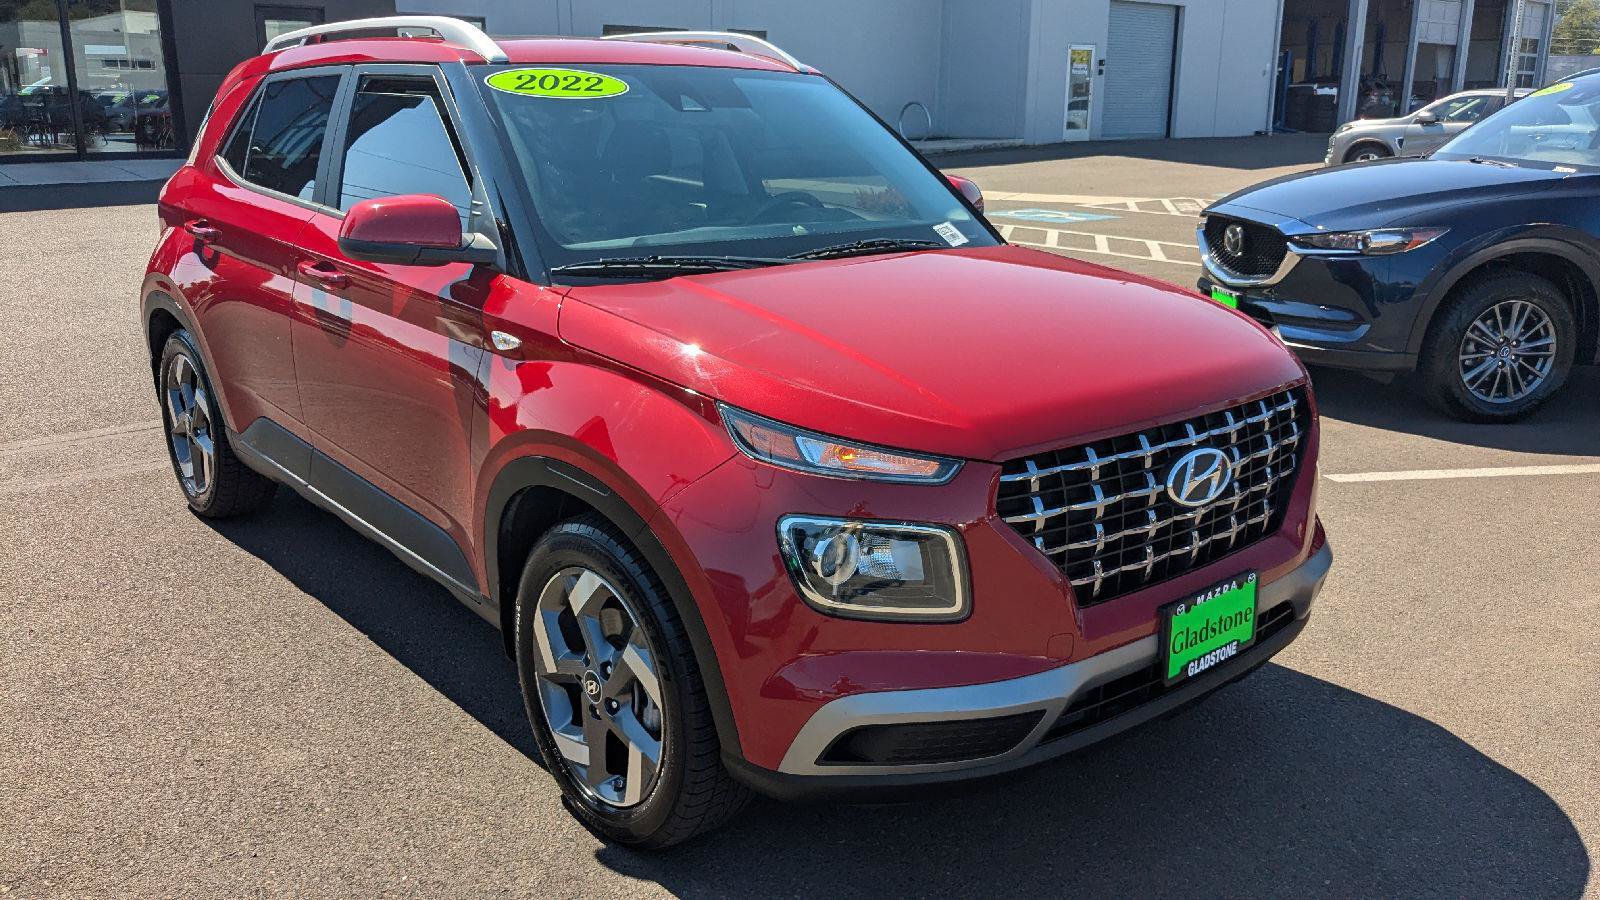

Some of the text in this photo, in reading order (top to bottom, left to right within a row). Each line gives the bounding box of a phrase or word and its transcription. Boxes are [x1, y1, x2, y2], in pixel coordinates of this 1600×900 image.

[514, 74, 604, 92] 2022
[1196, 580, 1238, 606] MAZDA
[1171, 606, 1253, 655] Gladstone
[1187, 640, 1238, 677] GLADSTONE
